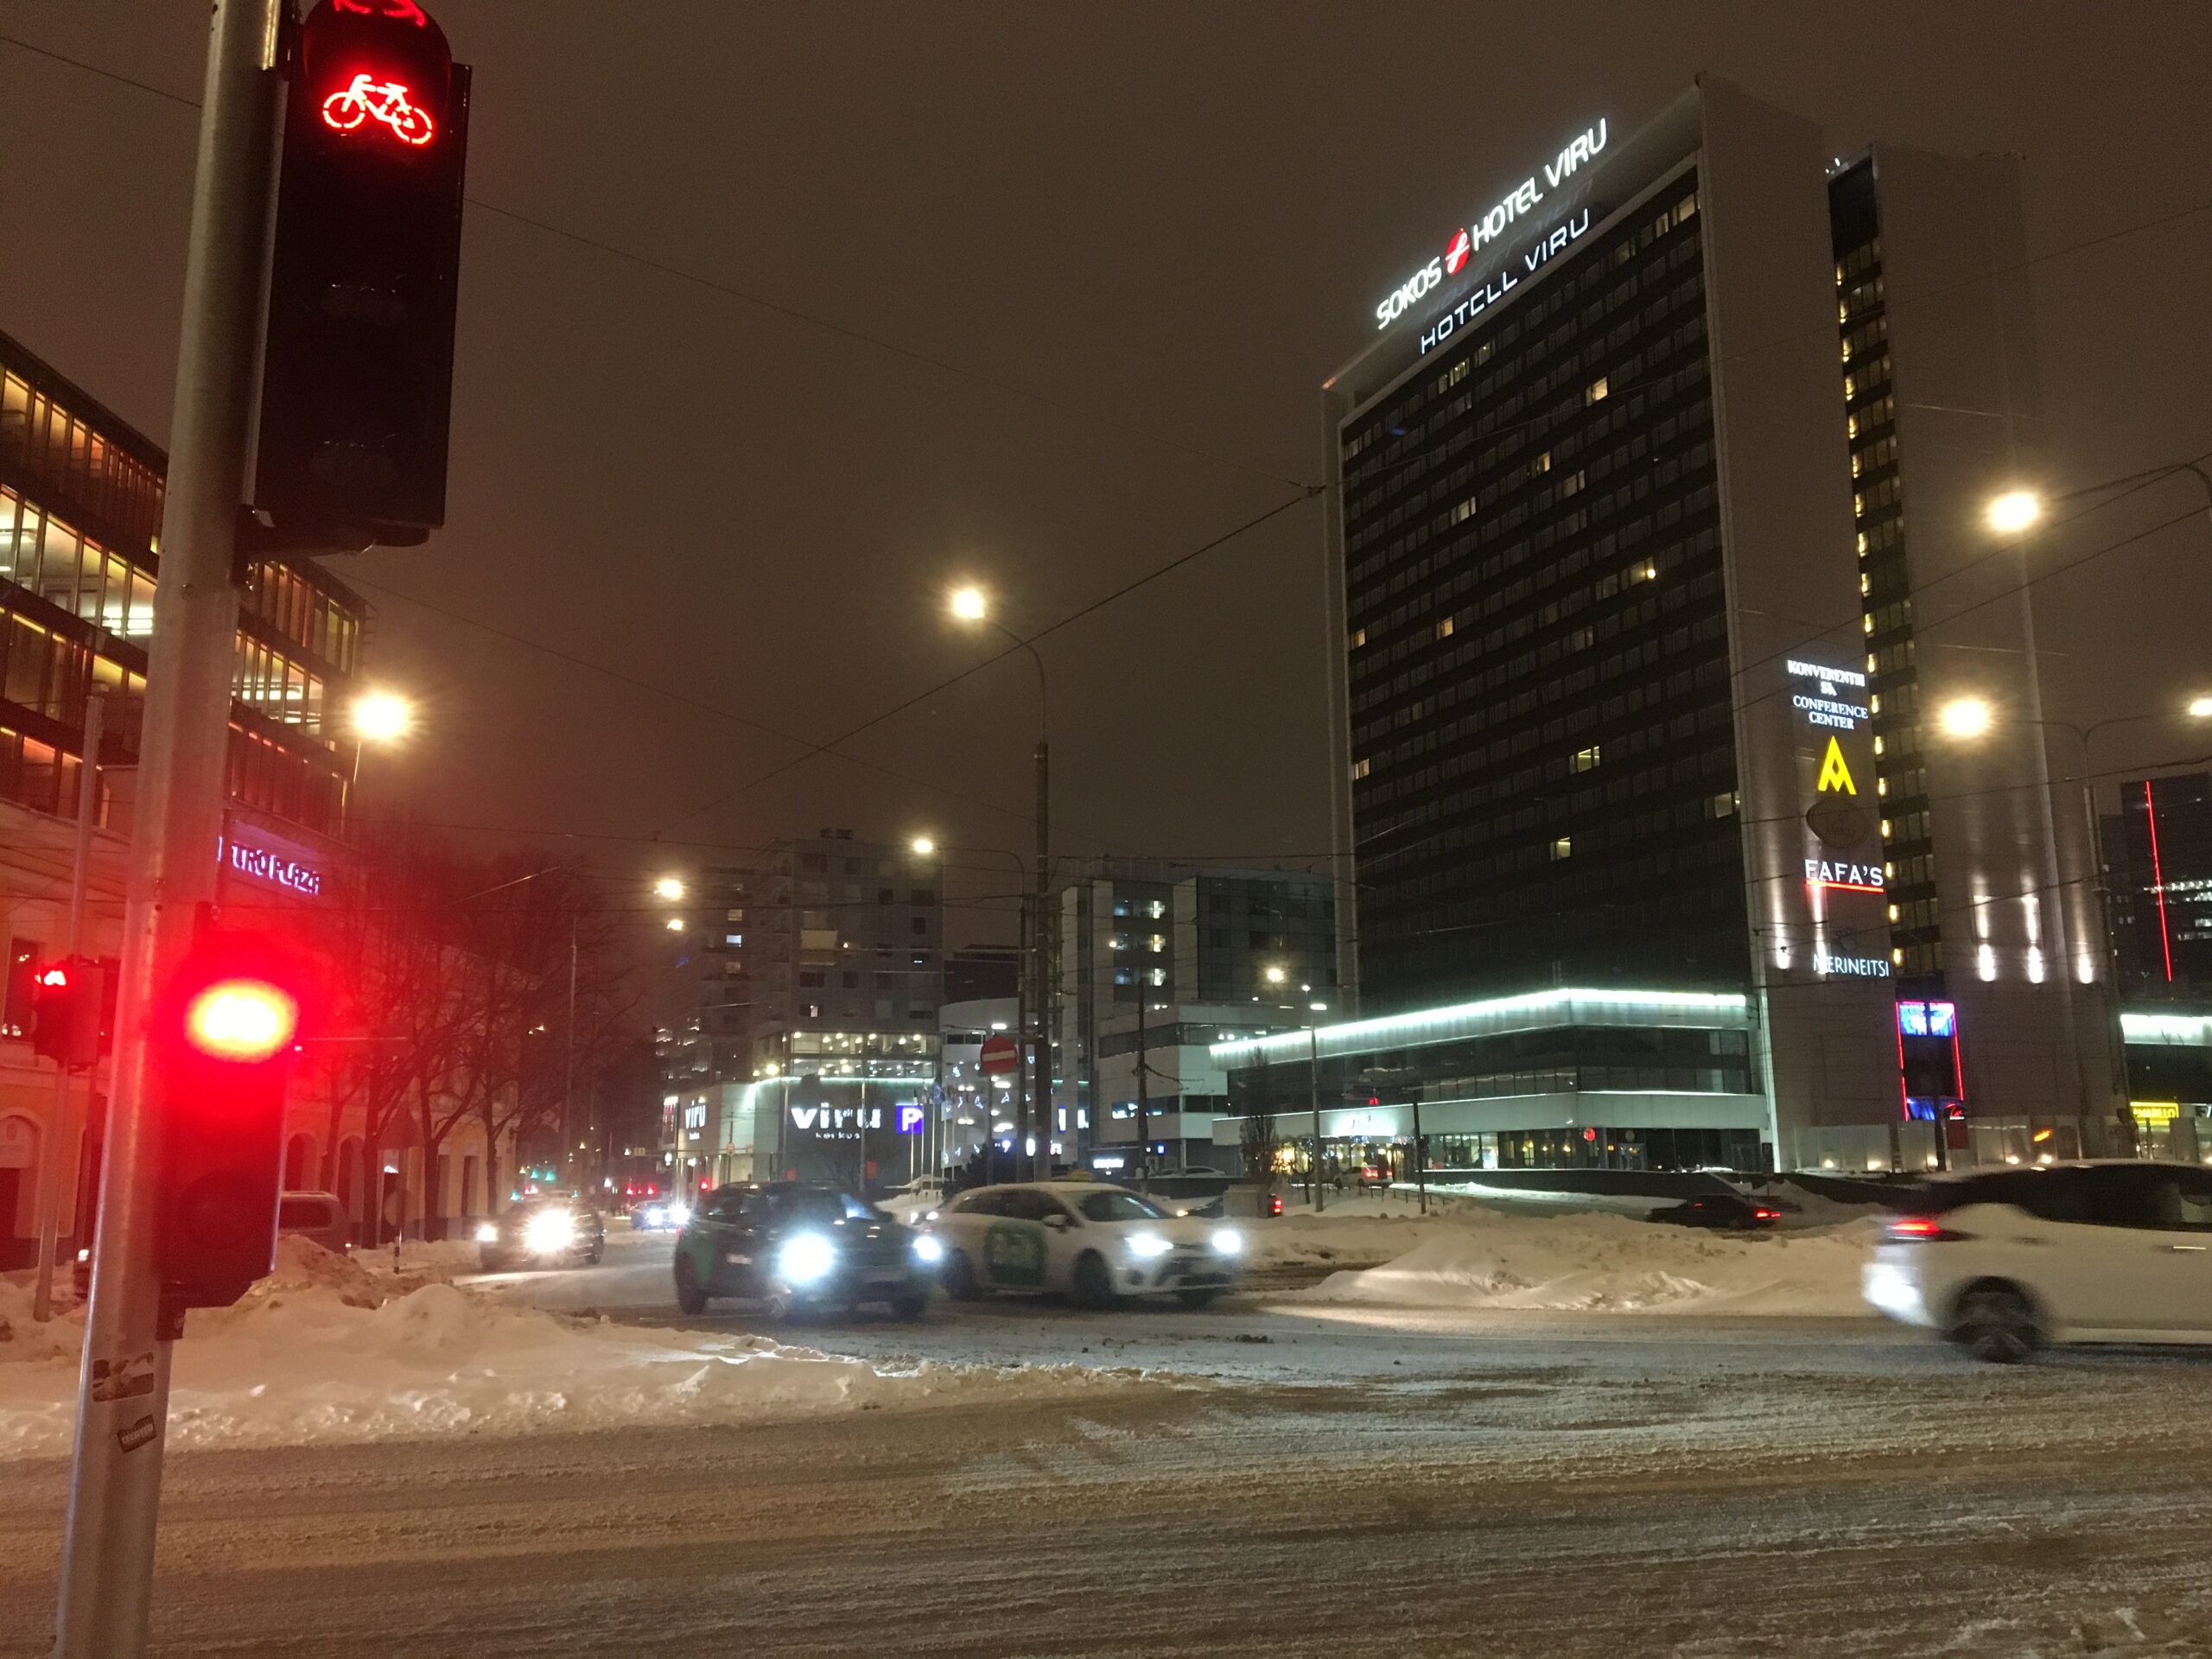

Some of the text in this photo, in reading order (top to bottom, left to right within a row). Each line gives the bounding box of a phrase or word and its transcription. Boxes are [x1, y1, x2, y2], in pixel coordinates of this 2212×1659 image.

[1376, 117, 1607, 330] SOKOS HOTEL VIRU
[1524, 207, 1590, 271] VIRU
[1792, 695, 1869, 719] CONFERENCE
[1808, 710, 1855, 729] CENTER
[1804, 858, 1885, 887] FAFA'S
[790, 1102, 881, 1129] viru
